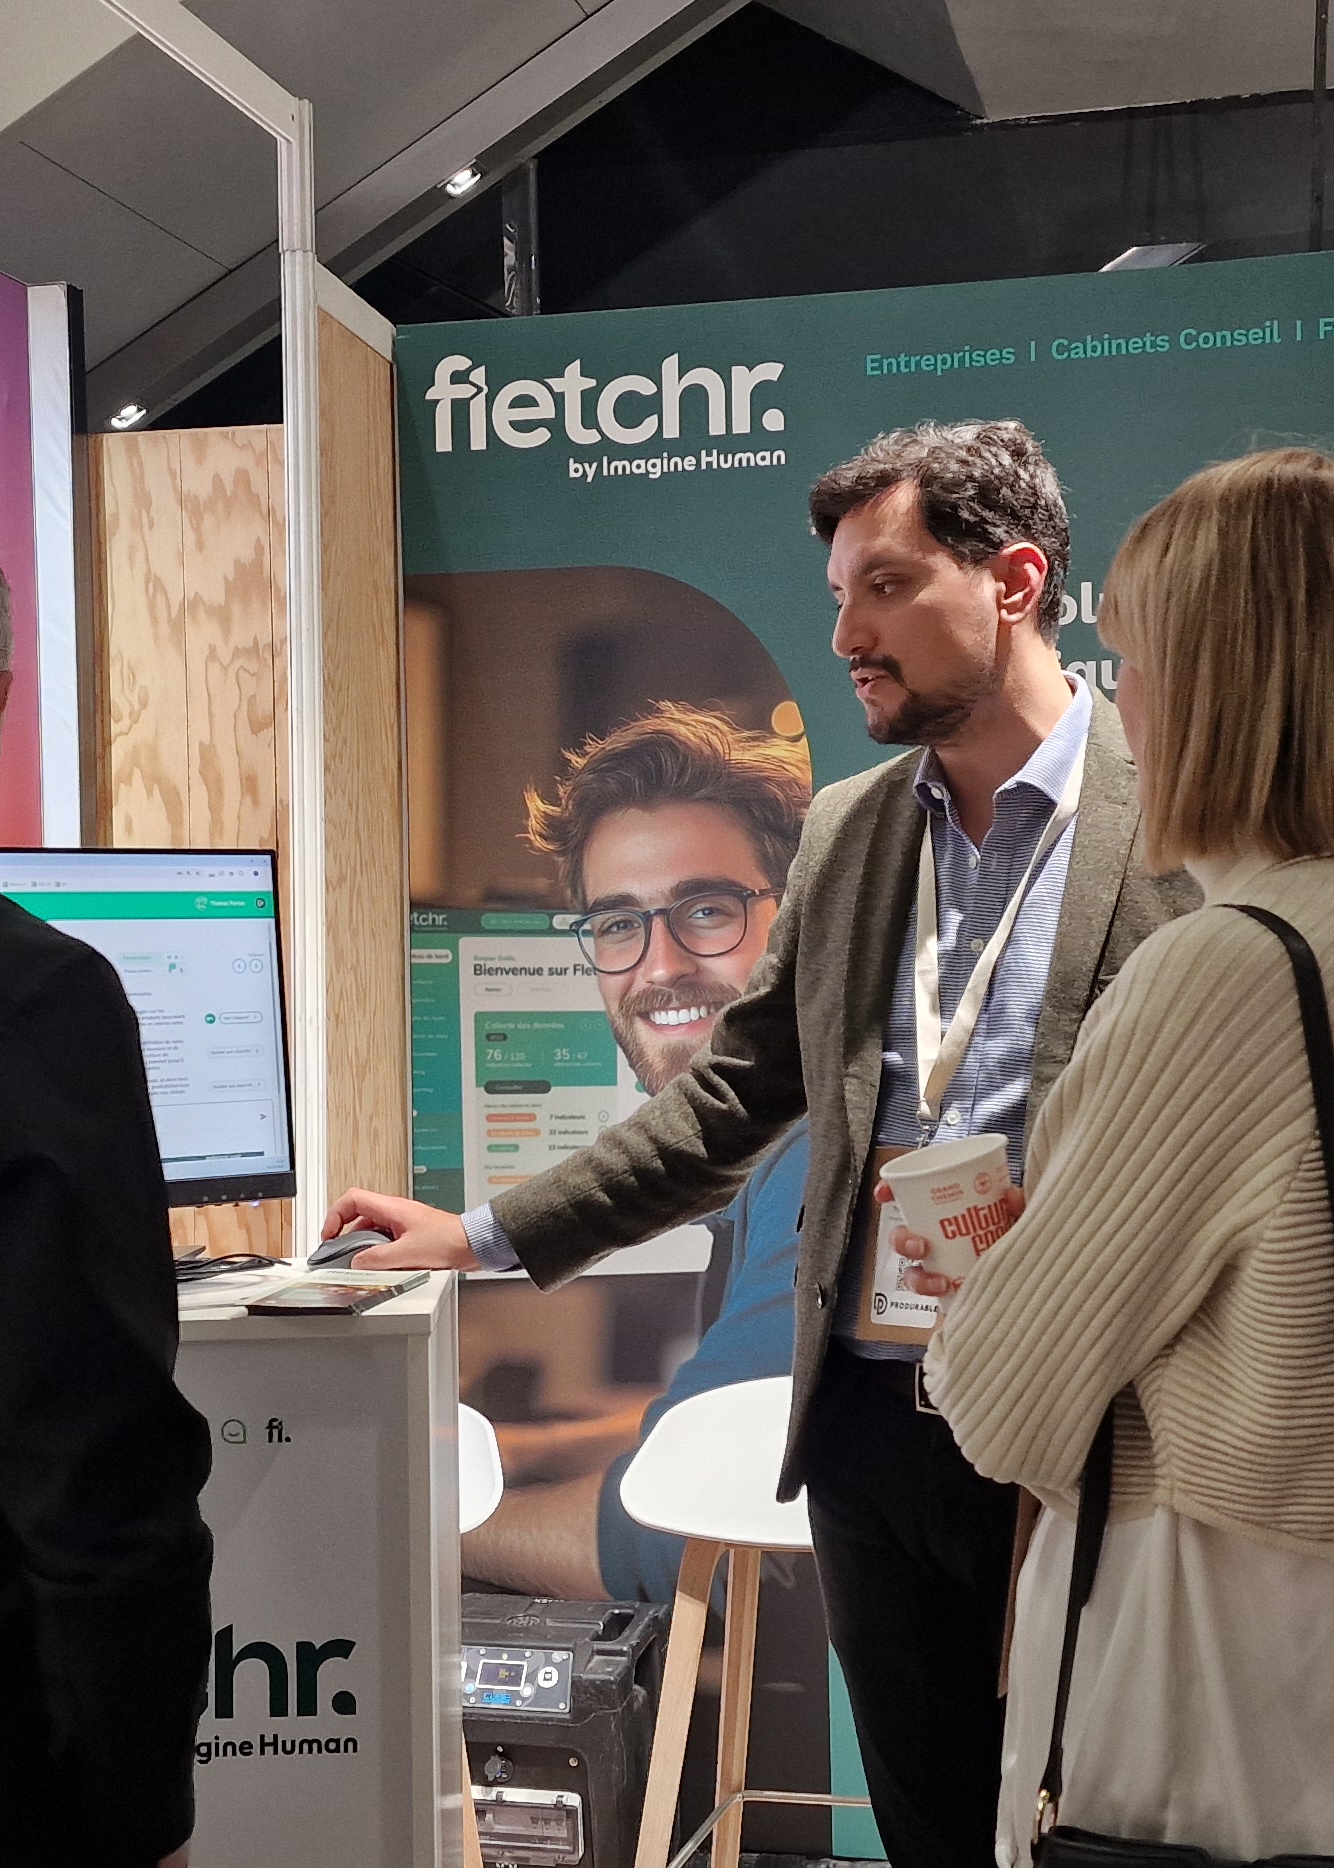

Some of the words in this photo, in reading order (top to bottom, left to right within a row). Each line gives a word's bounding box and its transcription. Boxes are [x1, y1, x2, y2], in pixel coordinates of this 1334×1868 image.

[865, 345, 1016, 376] Entreprises
[1051, 332, 1170, 361] Cabinets
[1179, 320, 1282, 351] Conseil
[569, 457, 598, 483] by
[602, 452, 697, 481] Imagine
[700, 448, 786, 470] Human
[411, 911, 449, 926] tchr.
[473, 963, 544, 976] Bienvenue
[547, 965, 570, 976] sur
[485, 1049, 503, 1061] 76
[553, 1048, 571, 1060] 35
[889, 1301, 939, 1313] PRODURABLE
[207, 1623, 357, 1719] hr.
[259, 1733, 358, 1757] Human
